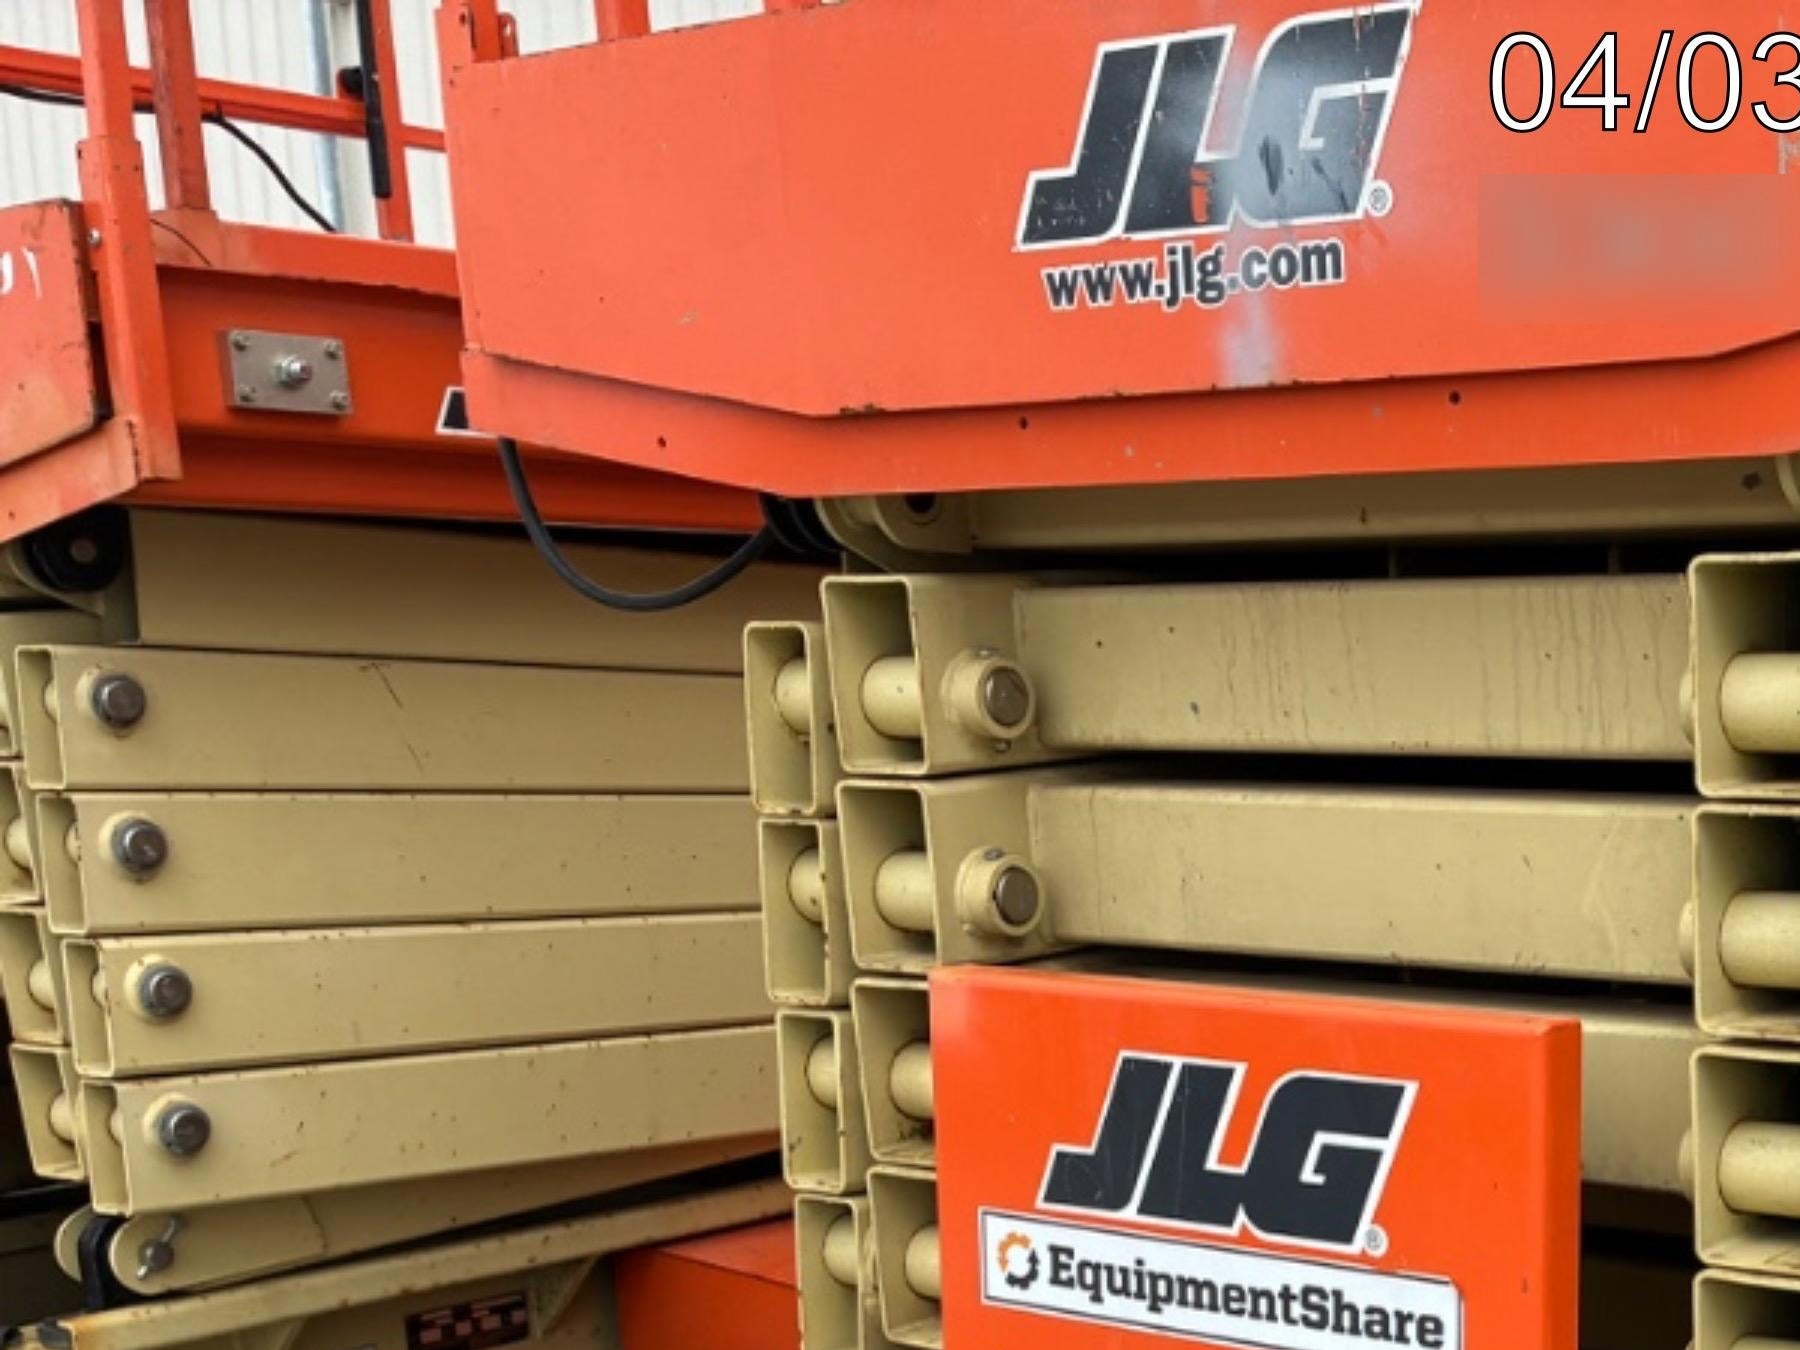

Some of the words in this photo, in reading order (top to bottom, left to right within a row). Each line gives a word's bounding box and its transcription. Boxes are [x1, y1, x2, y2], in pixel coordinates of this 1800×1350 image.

[1014, 1, 1420, 251] JLG
[1042, 238, 1344, 310] www.jlg.com
[1036, 1050, 1418, 1253] JLG
[1047, 1244, 1445, 1350] EquipmentShare
